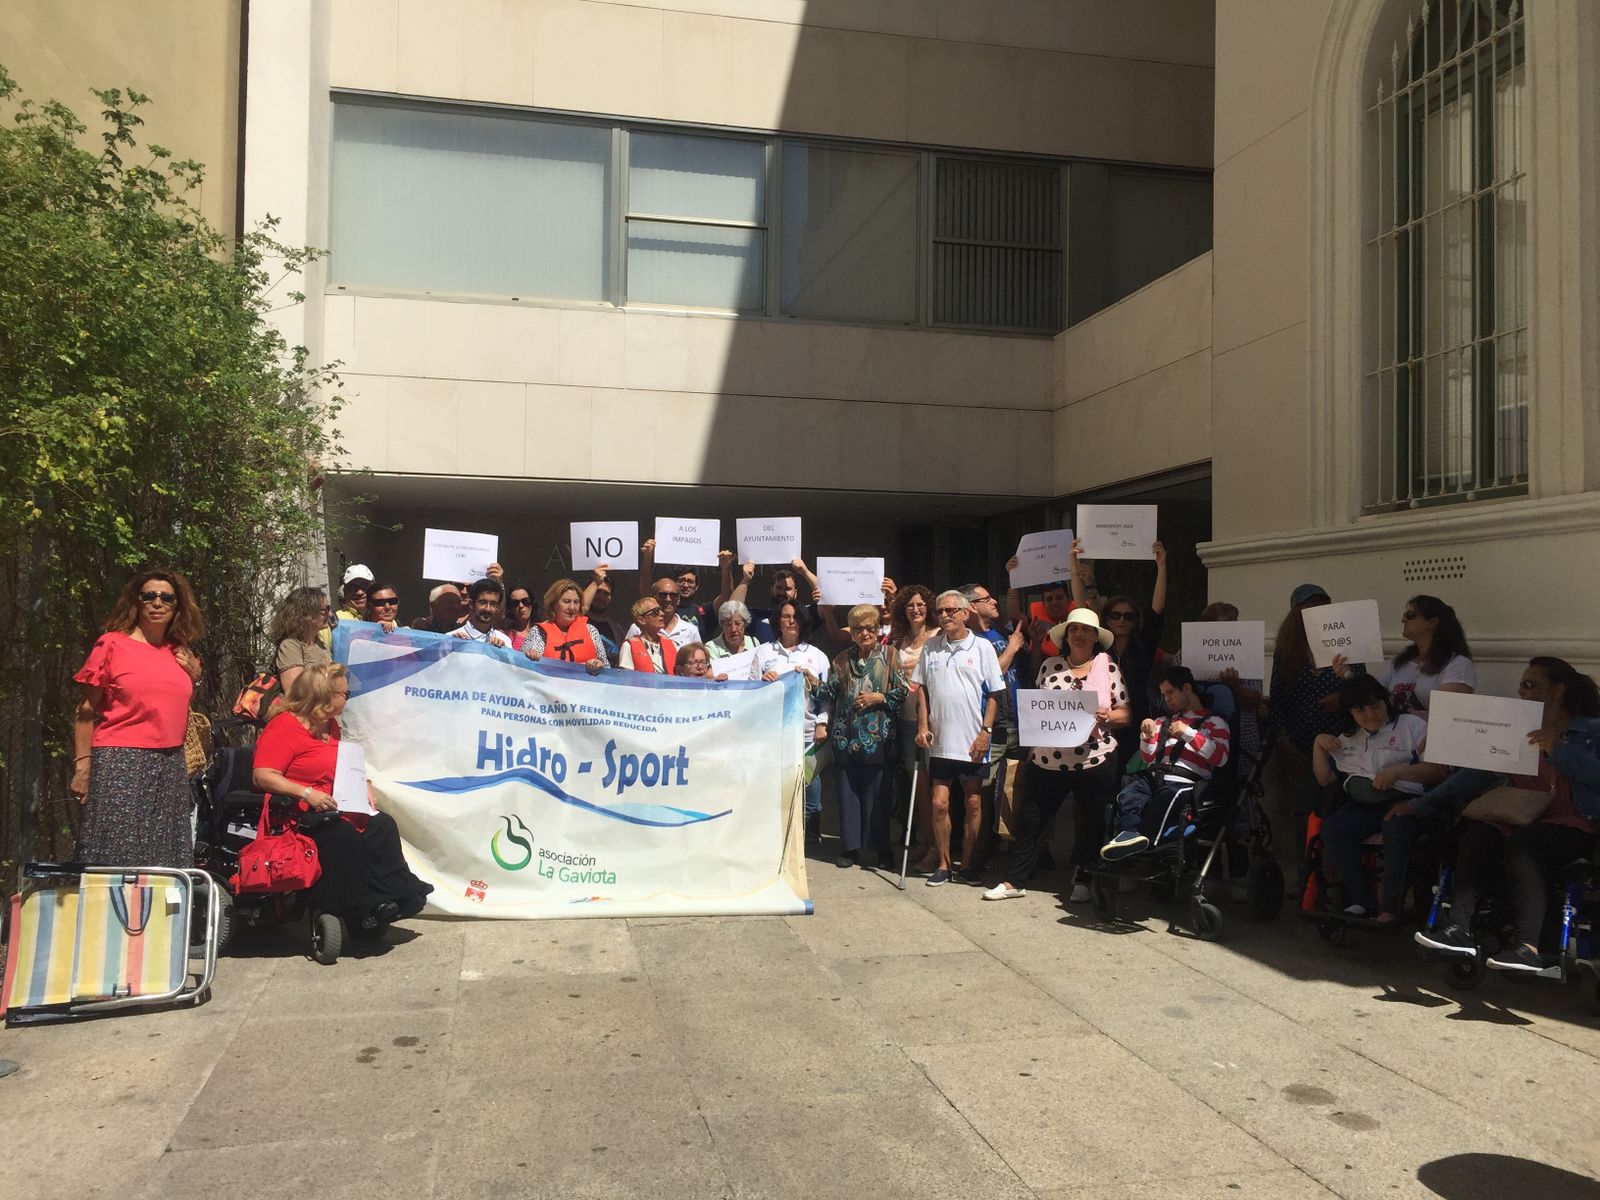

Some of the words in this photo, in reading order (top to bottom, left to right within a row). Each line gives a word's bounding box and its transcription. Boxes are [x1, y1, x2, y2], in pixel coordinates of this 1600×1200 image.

[684, 525, 697, 533] LOS
[672, 537, 702, 545] IMPAGOS
[743, 535, 795, 543] AYUNTAMIENTO
[585, 536, 623, 559] NO
[1322, 622, 1346, 632] PARA
[1202, 638, 1220, 647] POR
[1222, 638, 1242, 647] UNA
[1321, 636, 1352, 648] TOD@S
[1208, 653, 1236, 662] PLAYA
[404, 685, 469, 701] PROGRAMA
[472, 691, 487, 702] DE
[488, 694, 525, 709] AYUDA
[539, 700, 568, 714] BAÑO
[570, 703, 577, 713] Y
[579, 704, 673, 724] REHABILITACIÓN
[675, 716, 690, 724] EN
[692, 714, 704, 722] EL
[707, 710, 732, 720] MAR
[1031, 700, 1056, 711] POR
[1058, 700, 1085, 711] UNA
[481, 707, 502, 719] PARA
[503, 712, 547, 726] PERSONAS
[548, 719, 565, 727] CON
[565, 717, 612, 727] MOVILIDAD
[613, 720, 658, 733] REDUCIDA
[1041, 720, 1077, 732] PLAYA
[476, 729, 568, 784] Hidro
[602, 738, 690, 795] Sport
[538, 848, 597, 867] asociación
[538, 860, 554, 879] La
[558, 866, 617, 885] Gaviota
